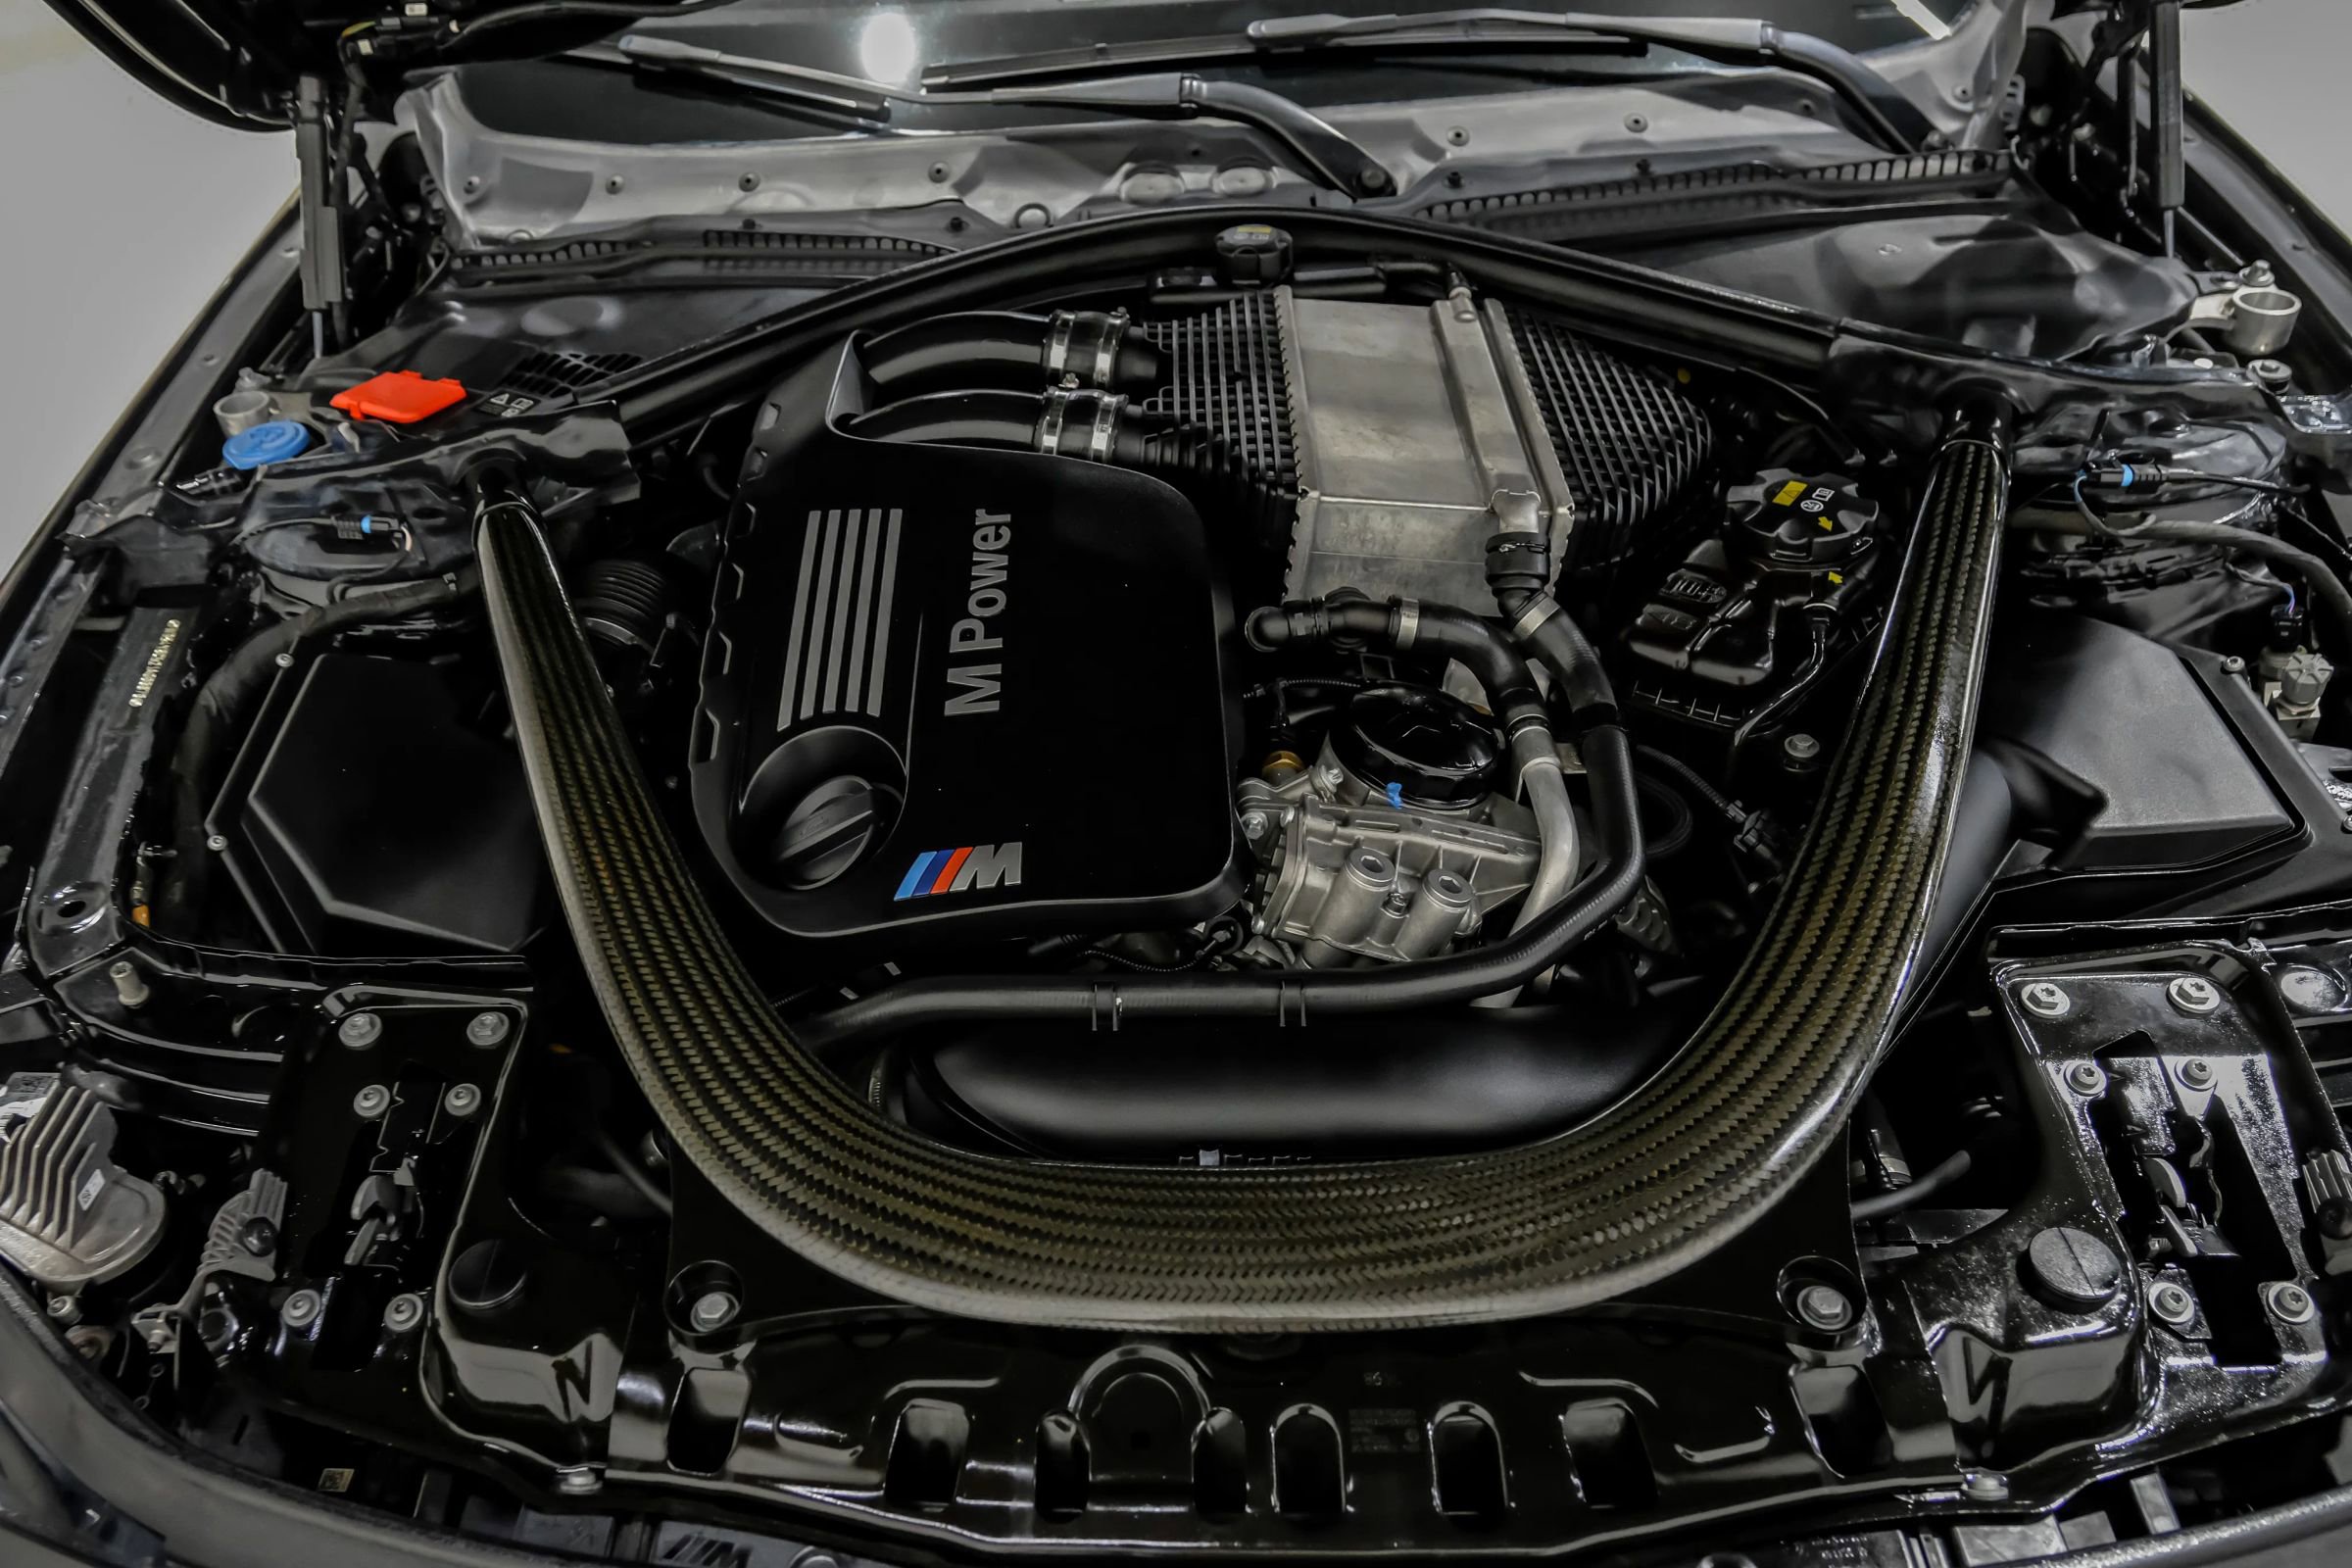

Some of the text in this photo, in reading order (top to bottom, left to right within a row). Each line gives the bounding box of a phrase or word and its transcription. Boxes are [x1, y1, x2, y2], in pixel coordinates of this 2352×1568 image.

[944, 508, 1012, 717] M Power
[949, 841, 1023, 893] M
